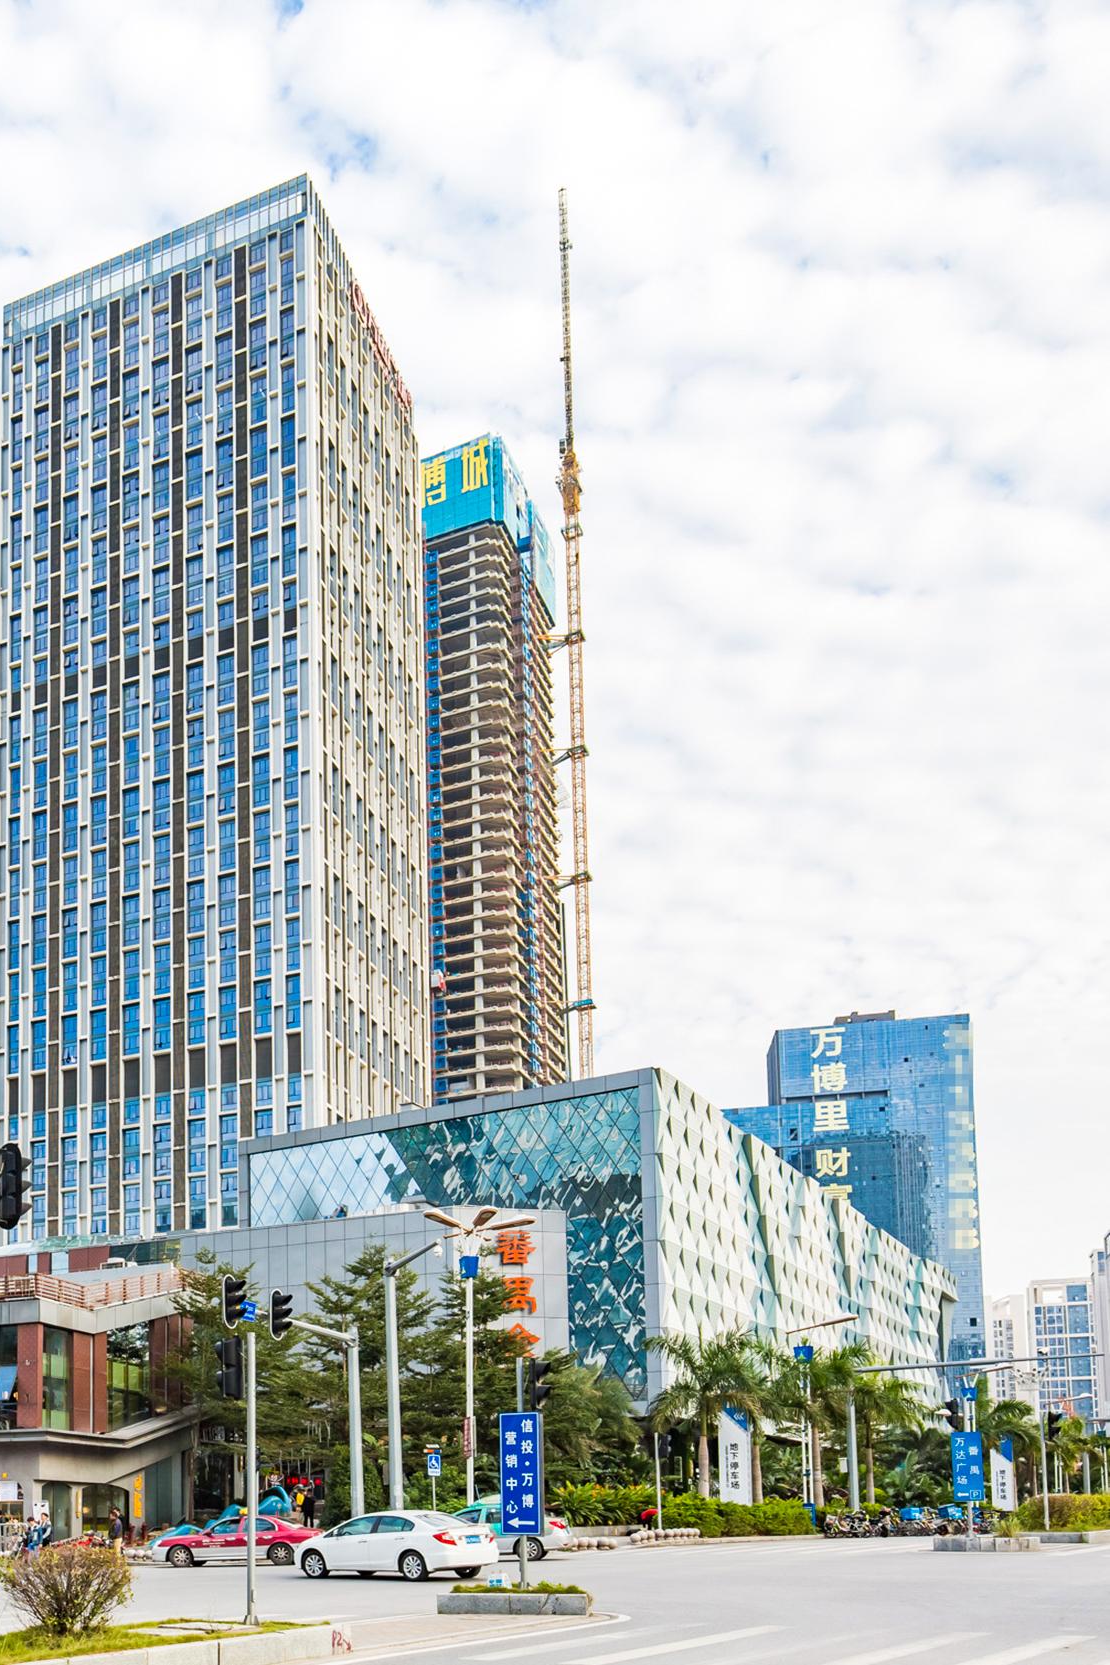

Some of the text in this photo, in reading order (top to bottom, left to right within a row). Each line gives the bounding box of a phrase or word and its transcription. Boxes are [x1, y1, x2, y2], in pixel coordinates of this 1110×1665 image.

[505, 1431, 518, 1514] 营销中心
[730, 1442, 740, 1490] 地下停车场
[955, 1437, 968, 1485] 万达广场
[969, 1446, 979, 1475] 番禺
[999, 1469, 1007, 1500] 地下停车场
